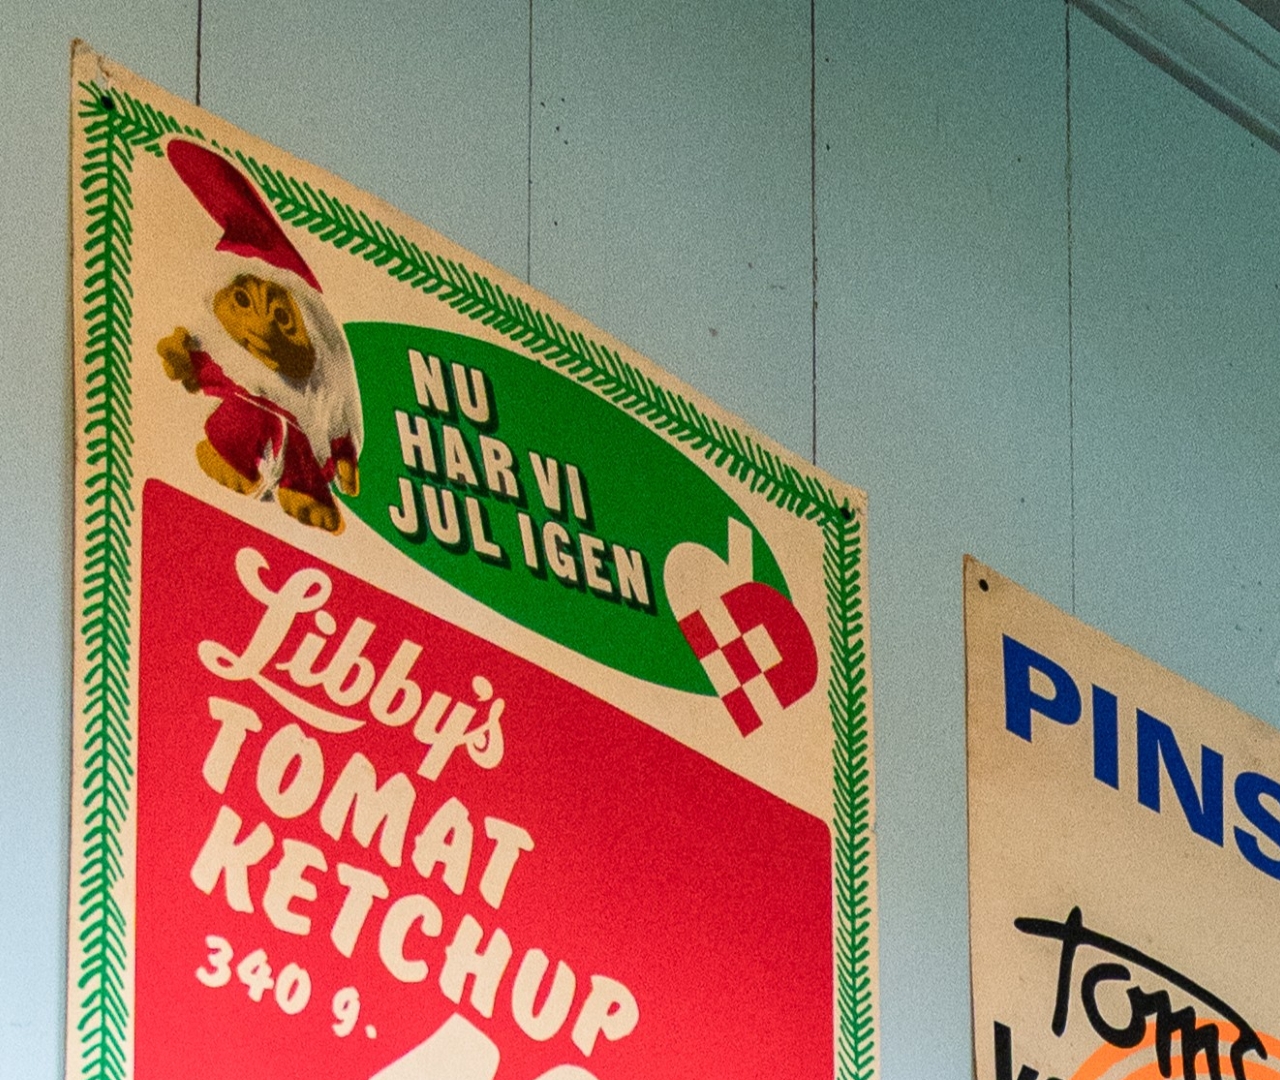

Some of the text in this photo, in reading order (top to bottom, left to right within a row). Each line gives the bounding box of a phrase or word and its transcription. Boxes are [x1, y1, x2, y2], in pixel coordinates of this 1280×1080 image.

[408, 350, 495, 424] NU
[394, 411, 593, 528] HAR VI
[389, 478, 655, 610] JUL IGEN
[197, 546, 506, 780] Libby's
[202, 697, 535, 909] TOMAT
[190, 806, 640, 1056] KETCHUP
[195, 934, 312, 1015] 340
